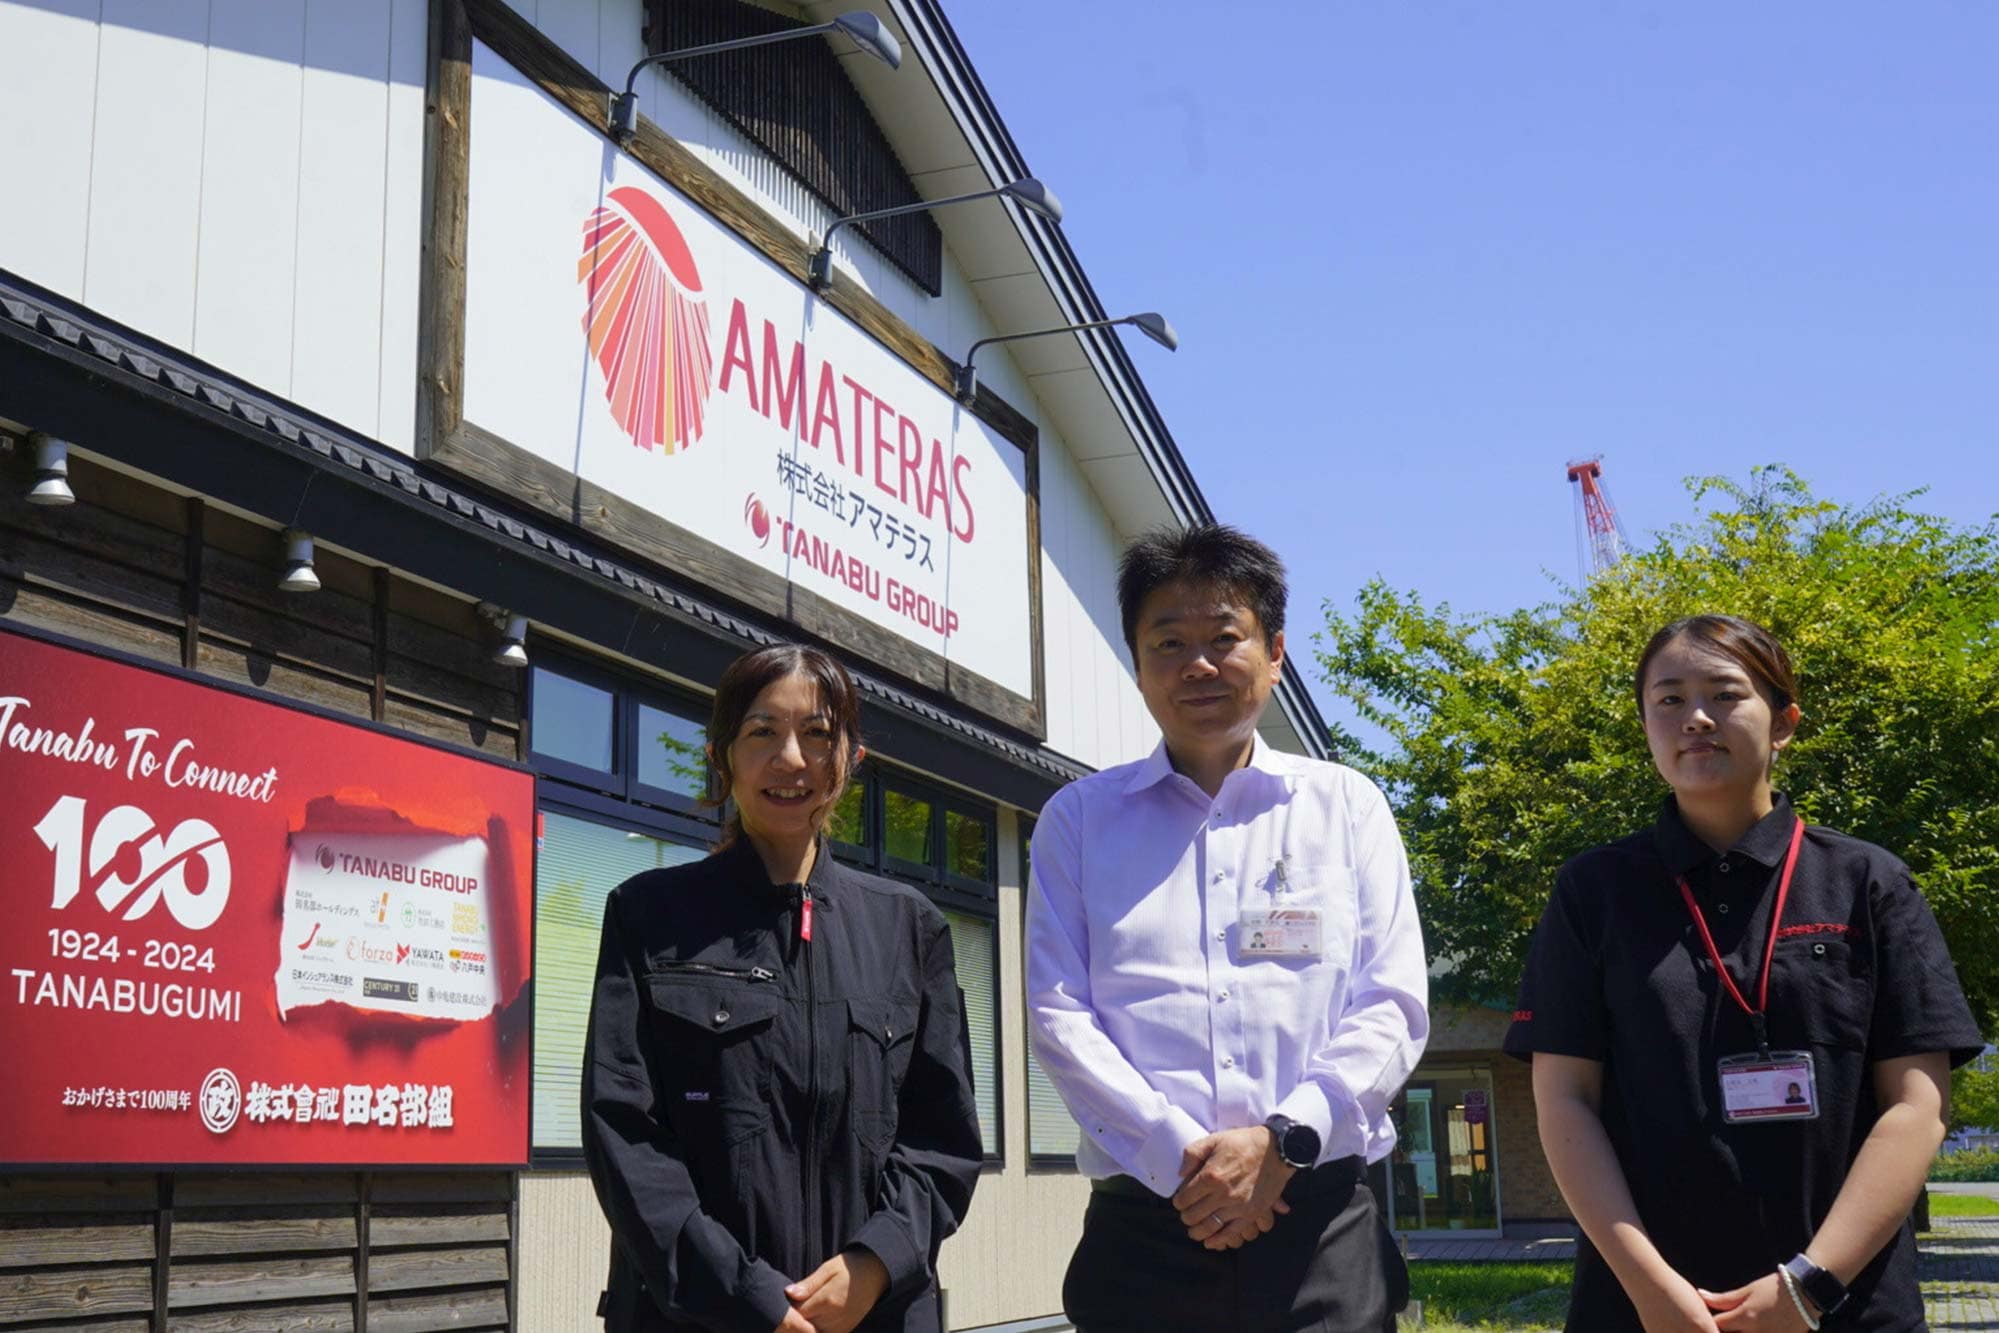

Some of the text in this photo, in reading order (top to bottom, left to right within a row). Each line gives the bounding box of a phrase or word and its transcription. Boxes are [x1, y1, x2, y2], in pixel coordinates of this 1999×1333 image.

[719, 298, 974, 543] AMATERAS
[777, 449, 934, 572] 株式会社アマテラス
[776, 516, 959, 639] TANABU GROUP
[0, 696, 278, 803] Tanabu To Connect
[33, 795, 231, 930] 100
[340, 853, 478, 895] TANABU GROUP
[48, 928, 120, 963] 1924
[144, 939, 215, 973] 2024
[361, 940, 393, 962] forza
[412, 947, 444, 962] YAWATA
[11, 968, 241, 1022] TANABUGUMI
[364, 980, 393, 992] CENTURY
[62, 1086, 192, 1111] おかげさまで100周年
